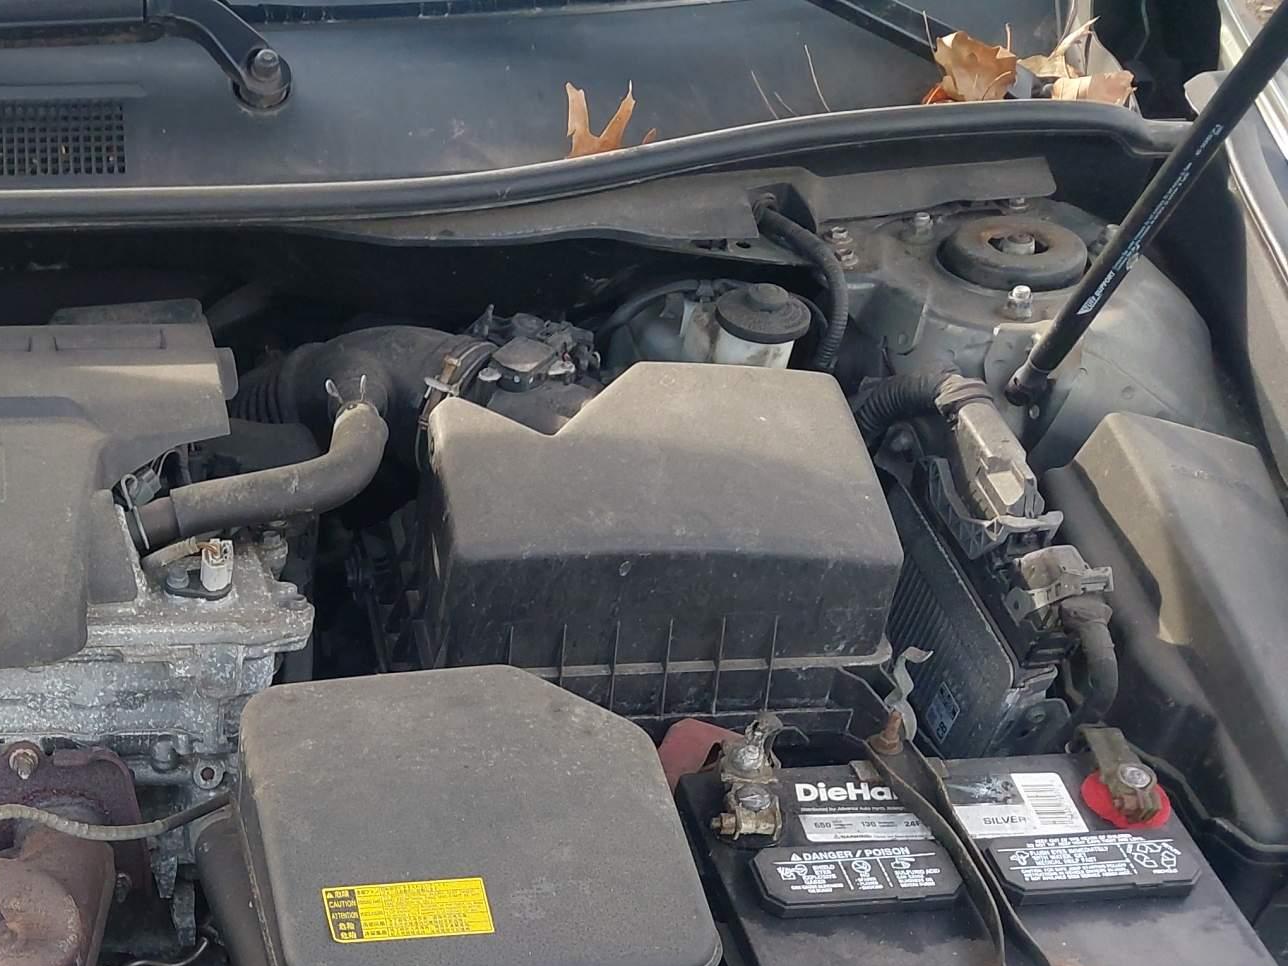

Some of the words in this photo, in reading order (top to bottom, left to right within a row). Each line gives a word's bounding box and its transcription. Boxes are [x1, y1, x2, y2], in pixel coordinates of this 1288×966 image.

[983, 815, 1028, 825] SILVER
[802, 850, 854, 861] DANGER
[863, 846, 911, 857] POISON
[328, 900, 357, 909] CAUTION
[332, 911, 360, 920] ATTENTION
